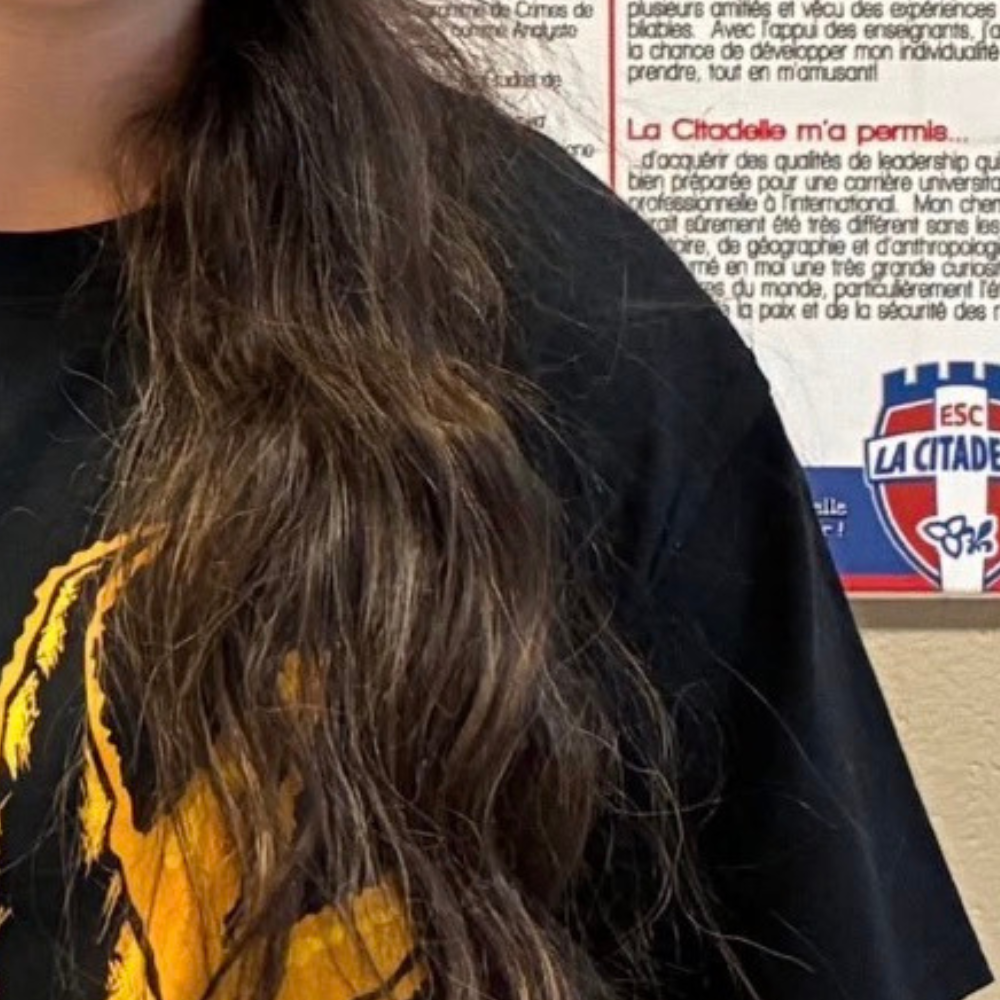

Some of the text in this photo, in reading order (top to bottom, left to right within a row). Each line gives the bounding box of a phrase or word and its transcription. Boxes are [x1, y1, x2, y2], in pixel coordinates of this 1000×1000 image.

[748, 64, 770, 81] en
[626, 118, 661, 140] La
[671, 118, 788, 141] Citadelle
[796, 119, 847, 142] m'a
[736, 298, 753, 318] la
[801, 299, 819, 319] et
[825, 299, 849, 319] de
[855, 299, 871, 319] la
[953, 300, 987, 320] des
[940, 403, 984, 427] ESC
[874, 435, 1000, 475] LA CITADE
